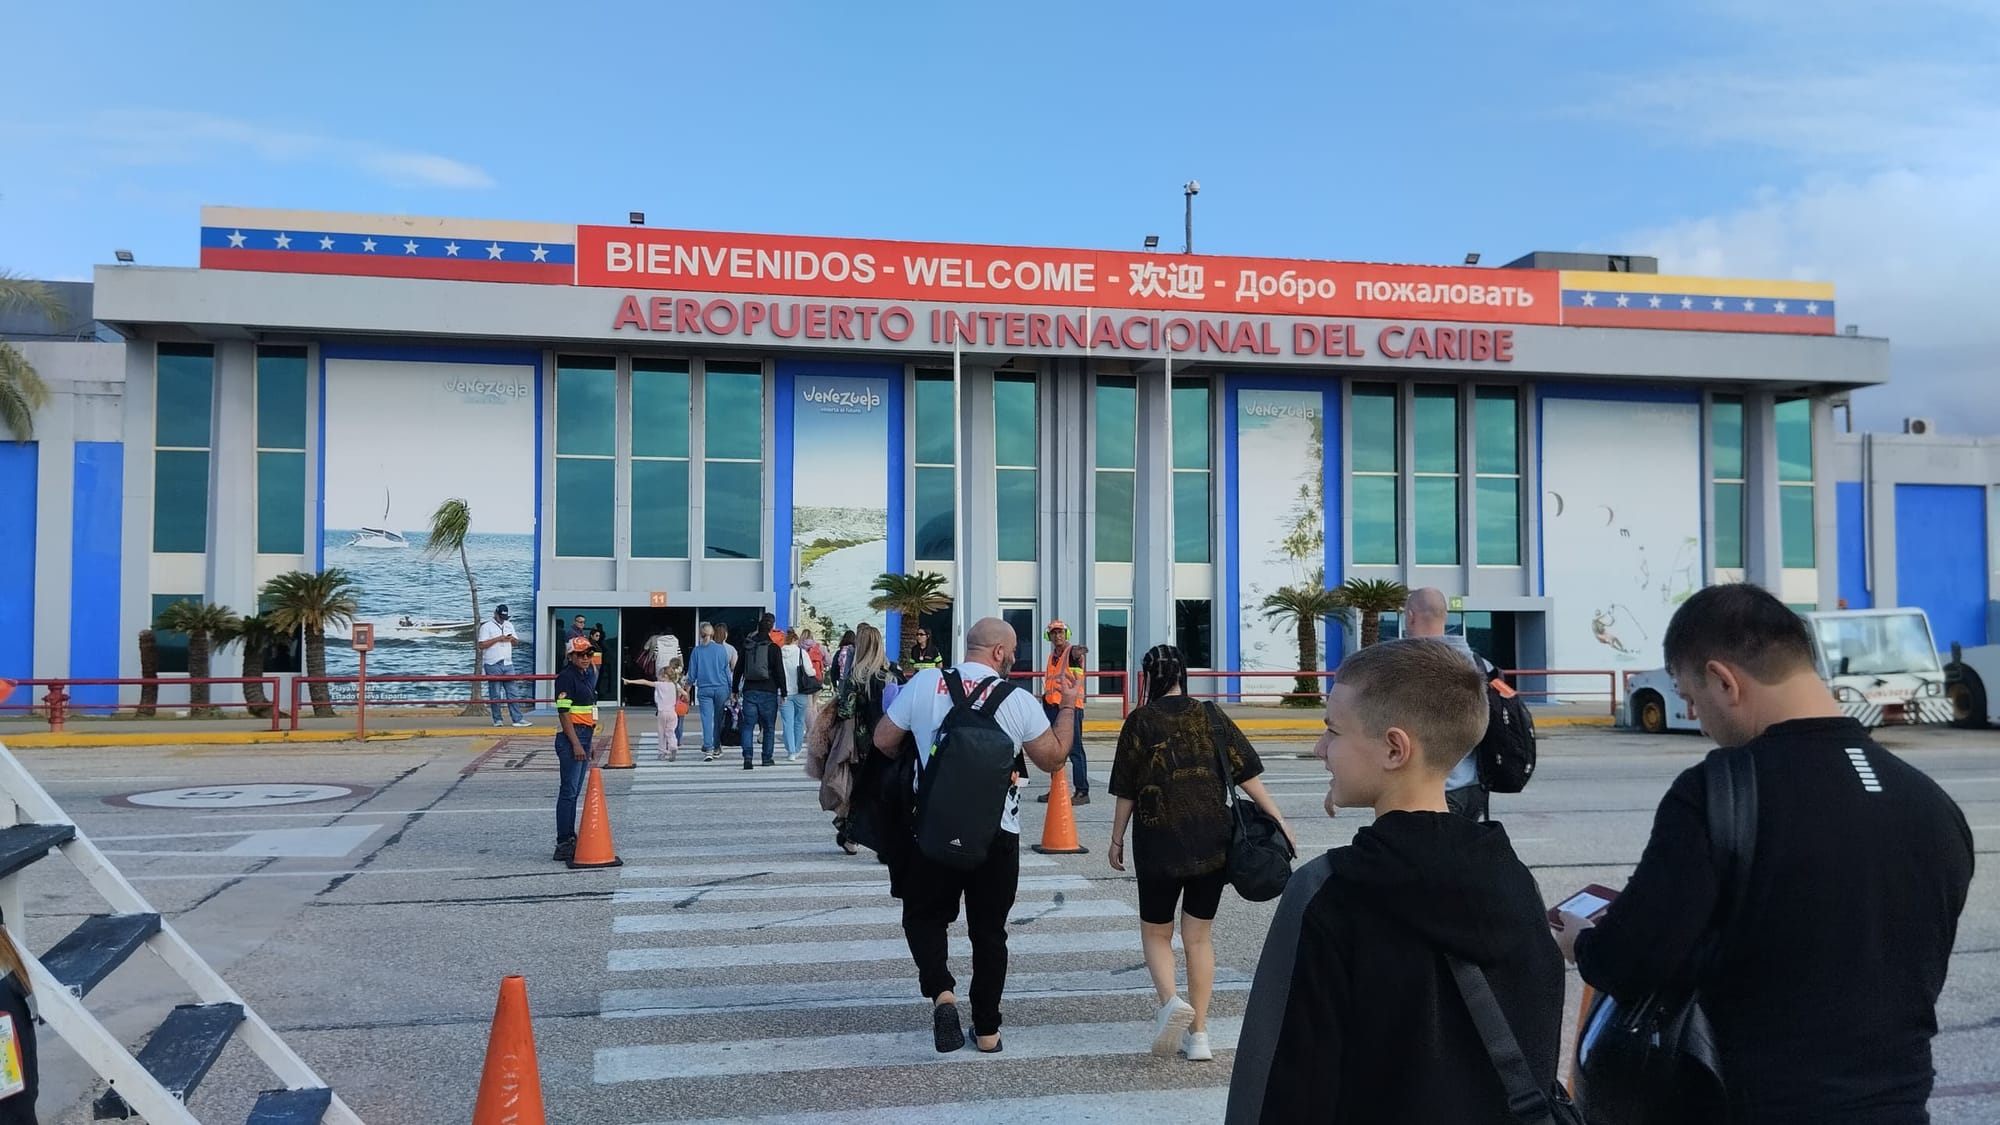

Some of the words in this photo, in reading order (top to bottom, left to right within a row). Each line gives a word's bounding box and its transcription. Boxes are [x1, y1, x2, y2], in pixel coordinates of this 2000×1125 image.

[606, 241, 876, 283] BIENVENIDOS
[903, 256, 1096, 292] WELCOME
[1128, 261, 1205, 300] 欢迎
[1235, 270, 1336, 305] Добро
[1356, 280, 1534, 308] пожаловать
[613, 295, 915, 342] AEROPUERTO
[931, 309, 1281, 355] INTERNACIONAL
[1293, 322, 1365, 357] DEL
[1378, 325, 1514, 362] CARIBE
[652, 595, 665, 604] 11
[1451, 599, 1462, 608] 12
